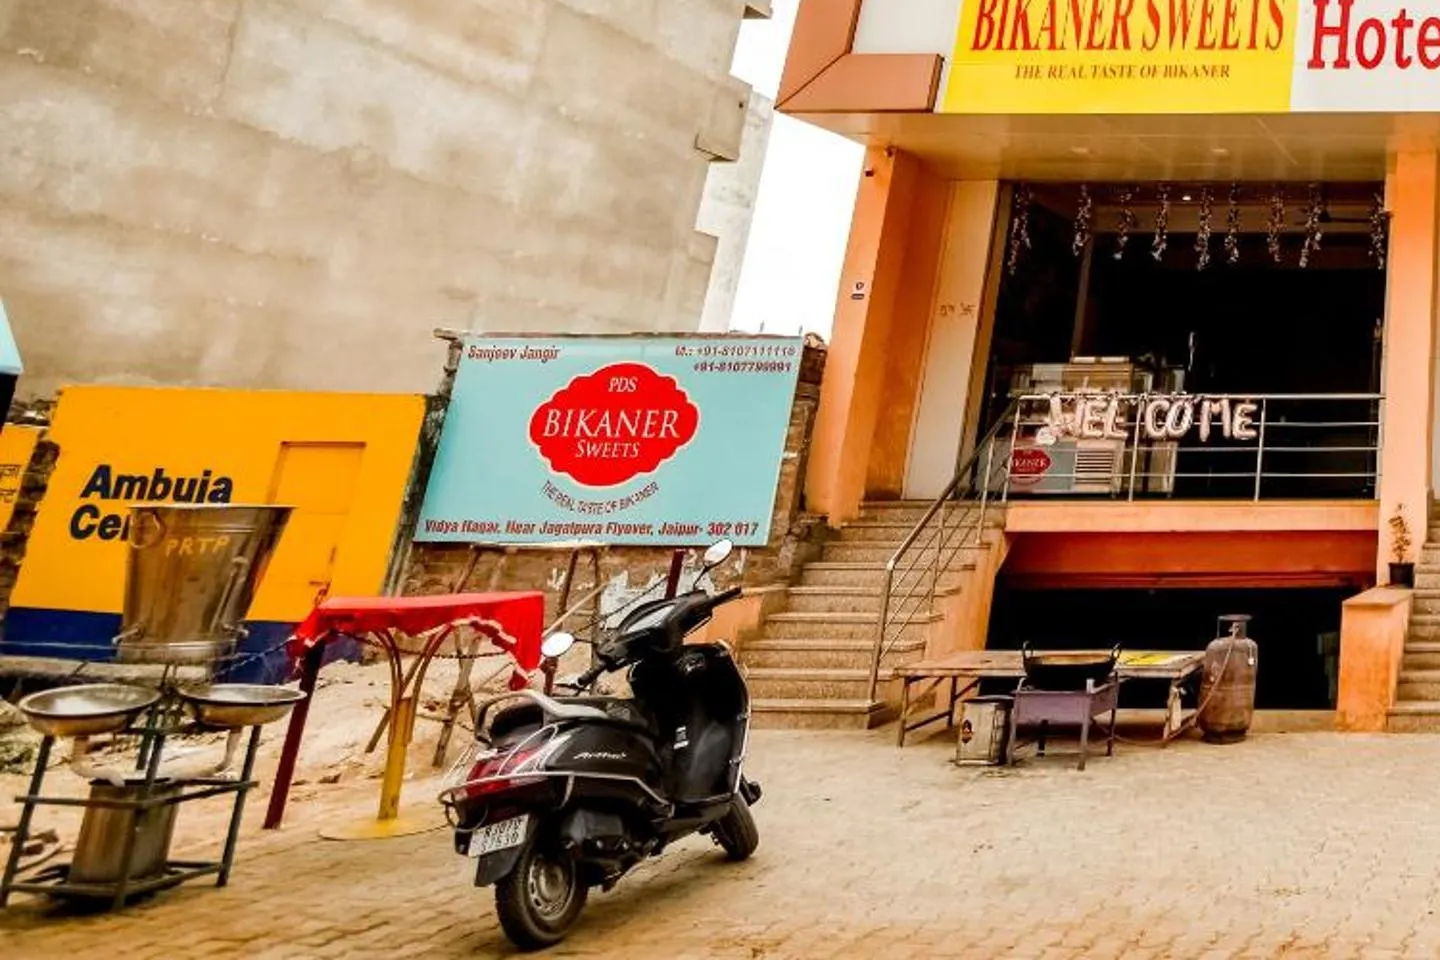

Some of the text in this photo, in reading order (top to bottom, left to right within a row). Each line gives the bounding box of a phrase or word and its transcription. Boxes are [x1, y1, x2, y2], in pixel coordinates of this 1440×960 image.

[1015, 63, 1231, 80] THE REAL TASTE OF BIKANER
[467, 345, 518, 362] Sanjeev
[520, 345, 561, 363] Jangir
[608, 377, 639, 392] PDS
[543, 408, 681, 439] BIKANER
[575, 440, 640, 458] SWEETS
[80, 464, 233, 504] Ambuja
[425, 519, 458, 534] Vidya
[505, 520, 536, 534] Near
[539, 521, 604, 536] Jagatpura
[707, 522, 731, 536] 302
[734, 522, 759, 536] 017
